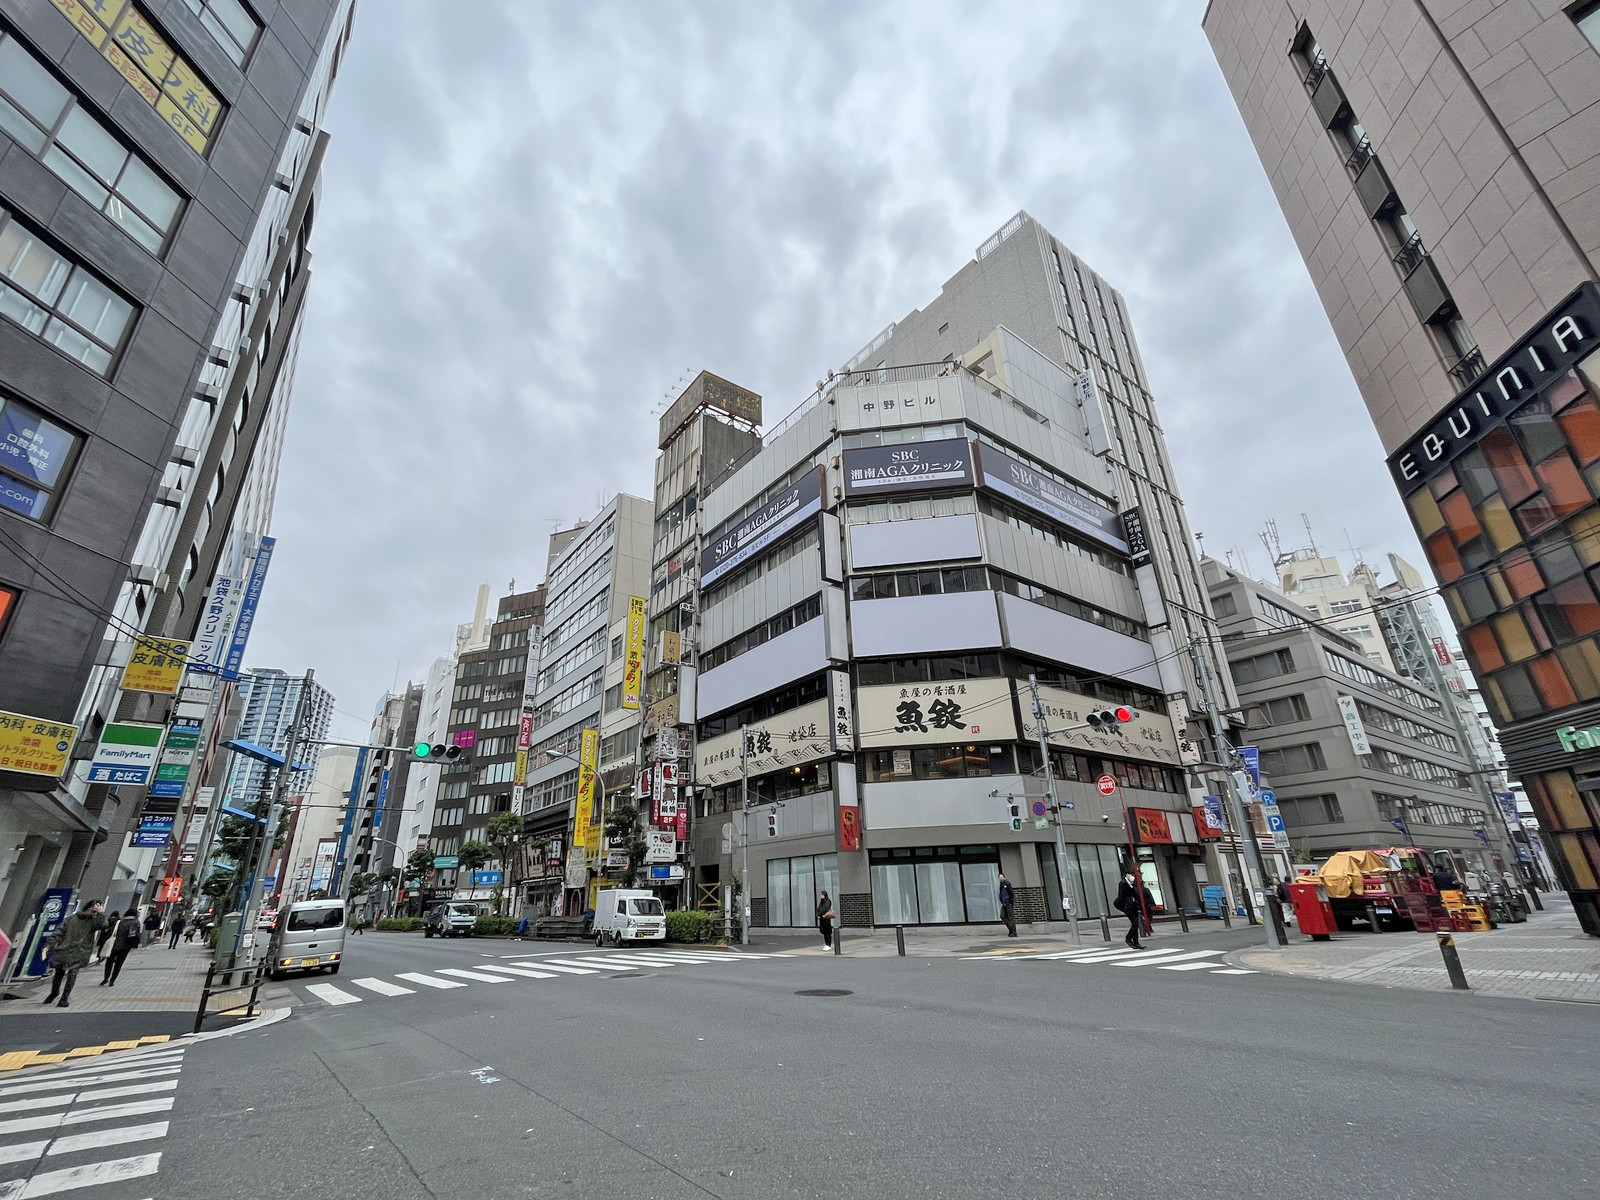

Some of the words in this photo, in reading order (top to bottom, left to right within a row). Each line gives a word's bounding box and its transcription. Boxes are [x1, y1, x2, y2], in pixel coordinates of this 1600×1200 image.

[171, 112, 196, 138] 6F
[863, 396, 935, 412] 中野ビル
[1400, 316, 1584, 480] EQUINIA
[7, 433, 50, 459] 口腔外科
[22, 428, 44, 444] 歯科
[891, 450, 919, 462] SBC
[851, 460, 963, 480] 湘南AGAクリニック
[1010, 463, 1039, 491] SBC
[715, 530, 738, 560] SBC
[196, 577, 231, 663] 池袋久野クリニック
[630, 619, 640, 649] カラオケ
[136, 638, 171, 655] 内科
[131, 652, 184, 670] 皮膚科
[899, 684, 967, 699] 魚屋の居酒屋
[0, 717, 73, 740] 内科・皮膚科
[1345, 712, 1366, 751] 商工中金
[100, 749, 151, 759] FamilyMart
[583, 734, 592, 762] カラオケ
[94, 769, 111, 781] 酒
[114, 770, 143, 782] たばこ
[1270, 817, 1281, 830] P
